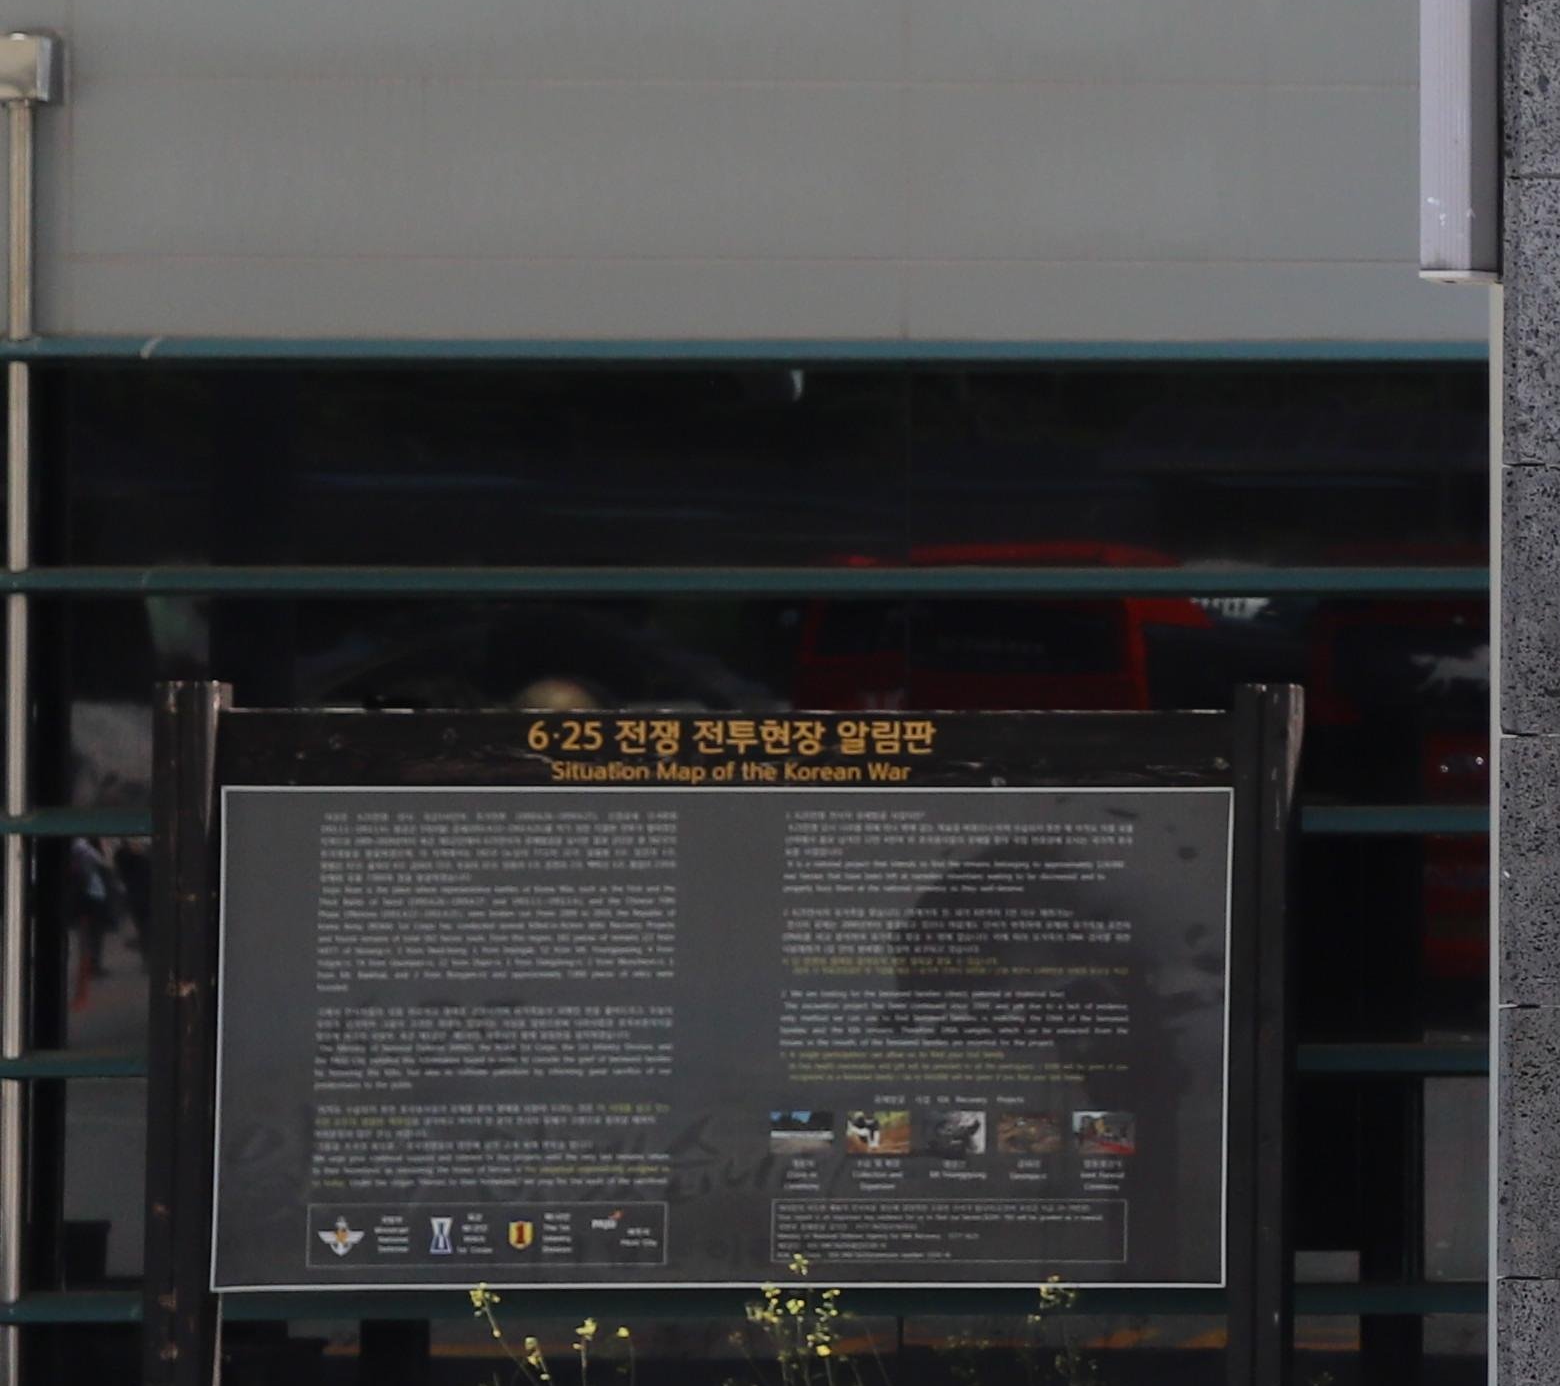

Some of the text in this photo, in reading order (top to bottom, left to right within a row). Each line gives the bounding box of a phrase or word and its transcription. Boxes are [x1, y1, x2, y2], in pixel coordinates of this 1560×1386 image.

[616, 721, 680, 754] 전쟁
[694, 721, 827, 754] 전투현장
[838, 721, 935, 754] 알림판
[552, 762, 910, 783] Situation Map of the Korean War
